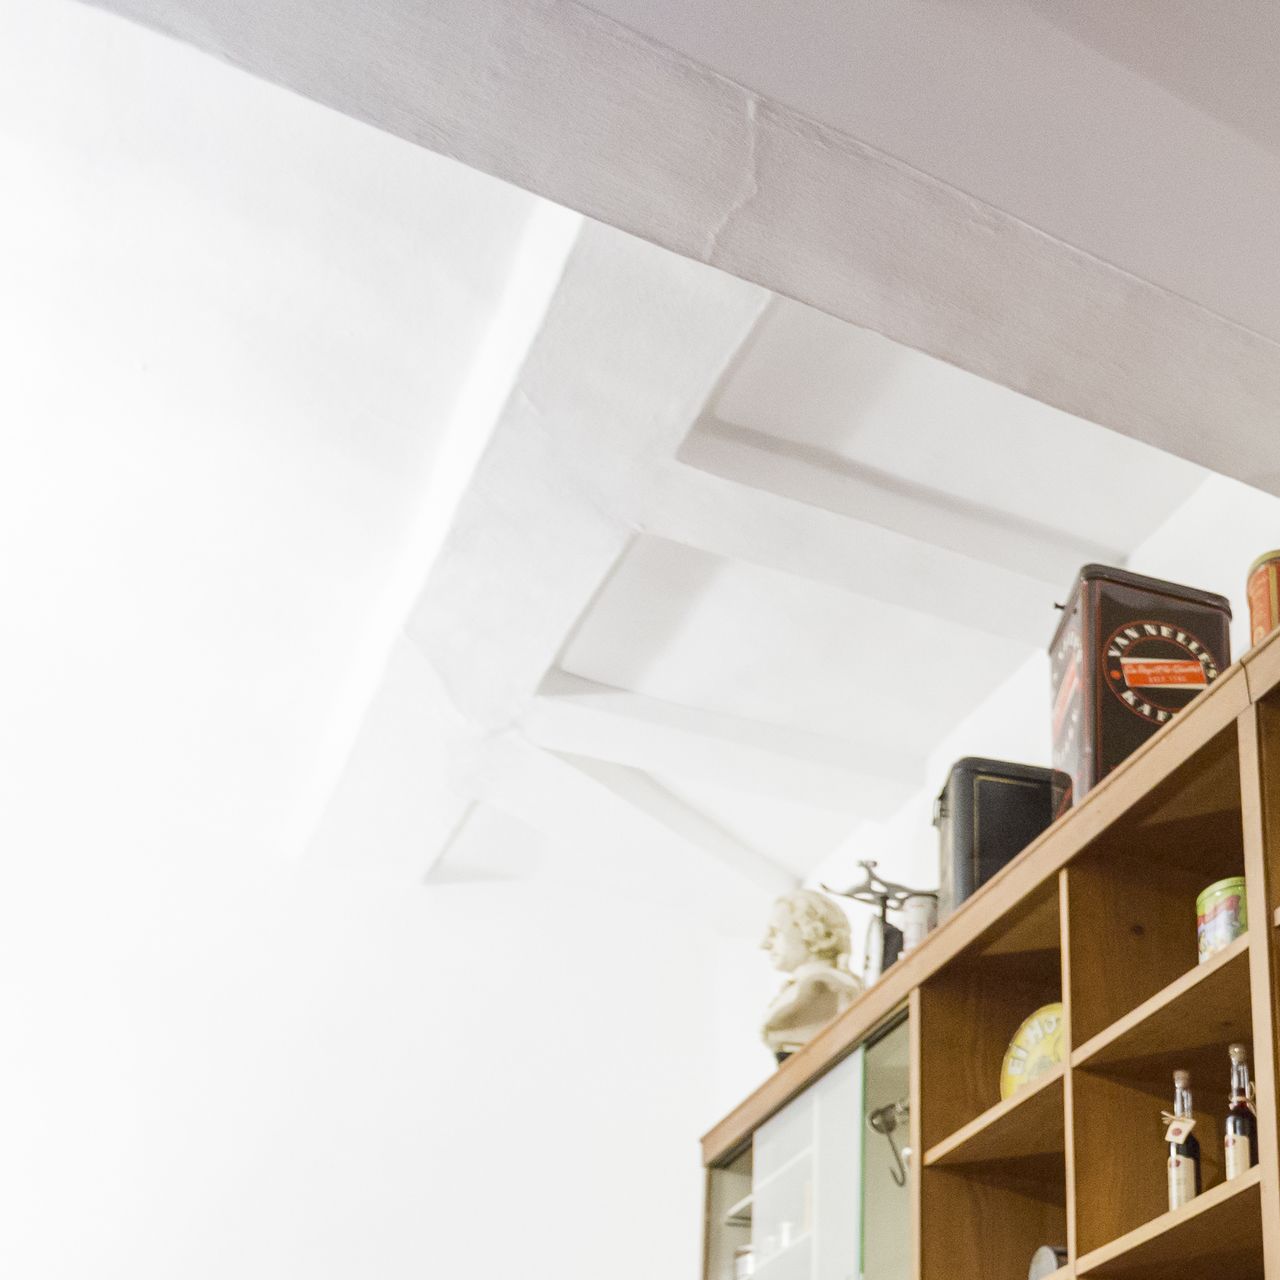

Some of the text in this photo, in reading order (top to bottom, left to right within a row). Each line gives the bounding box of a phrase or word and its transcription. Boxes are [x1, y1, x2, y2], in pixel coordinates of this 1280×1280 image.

[1108, 628, 1140, 657] VAN
[1144, 624, 1218, 678] NELLE'S
[1121, 690, 1178, 722] KAF
